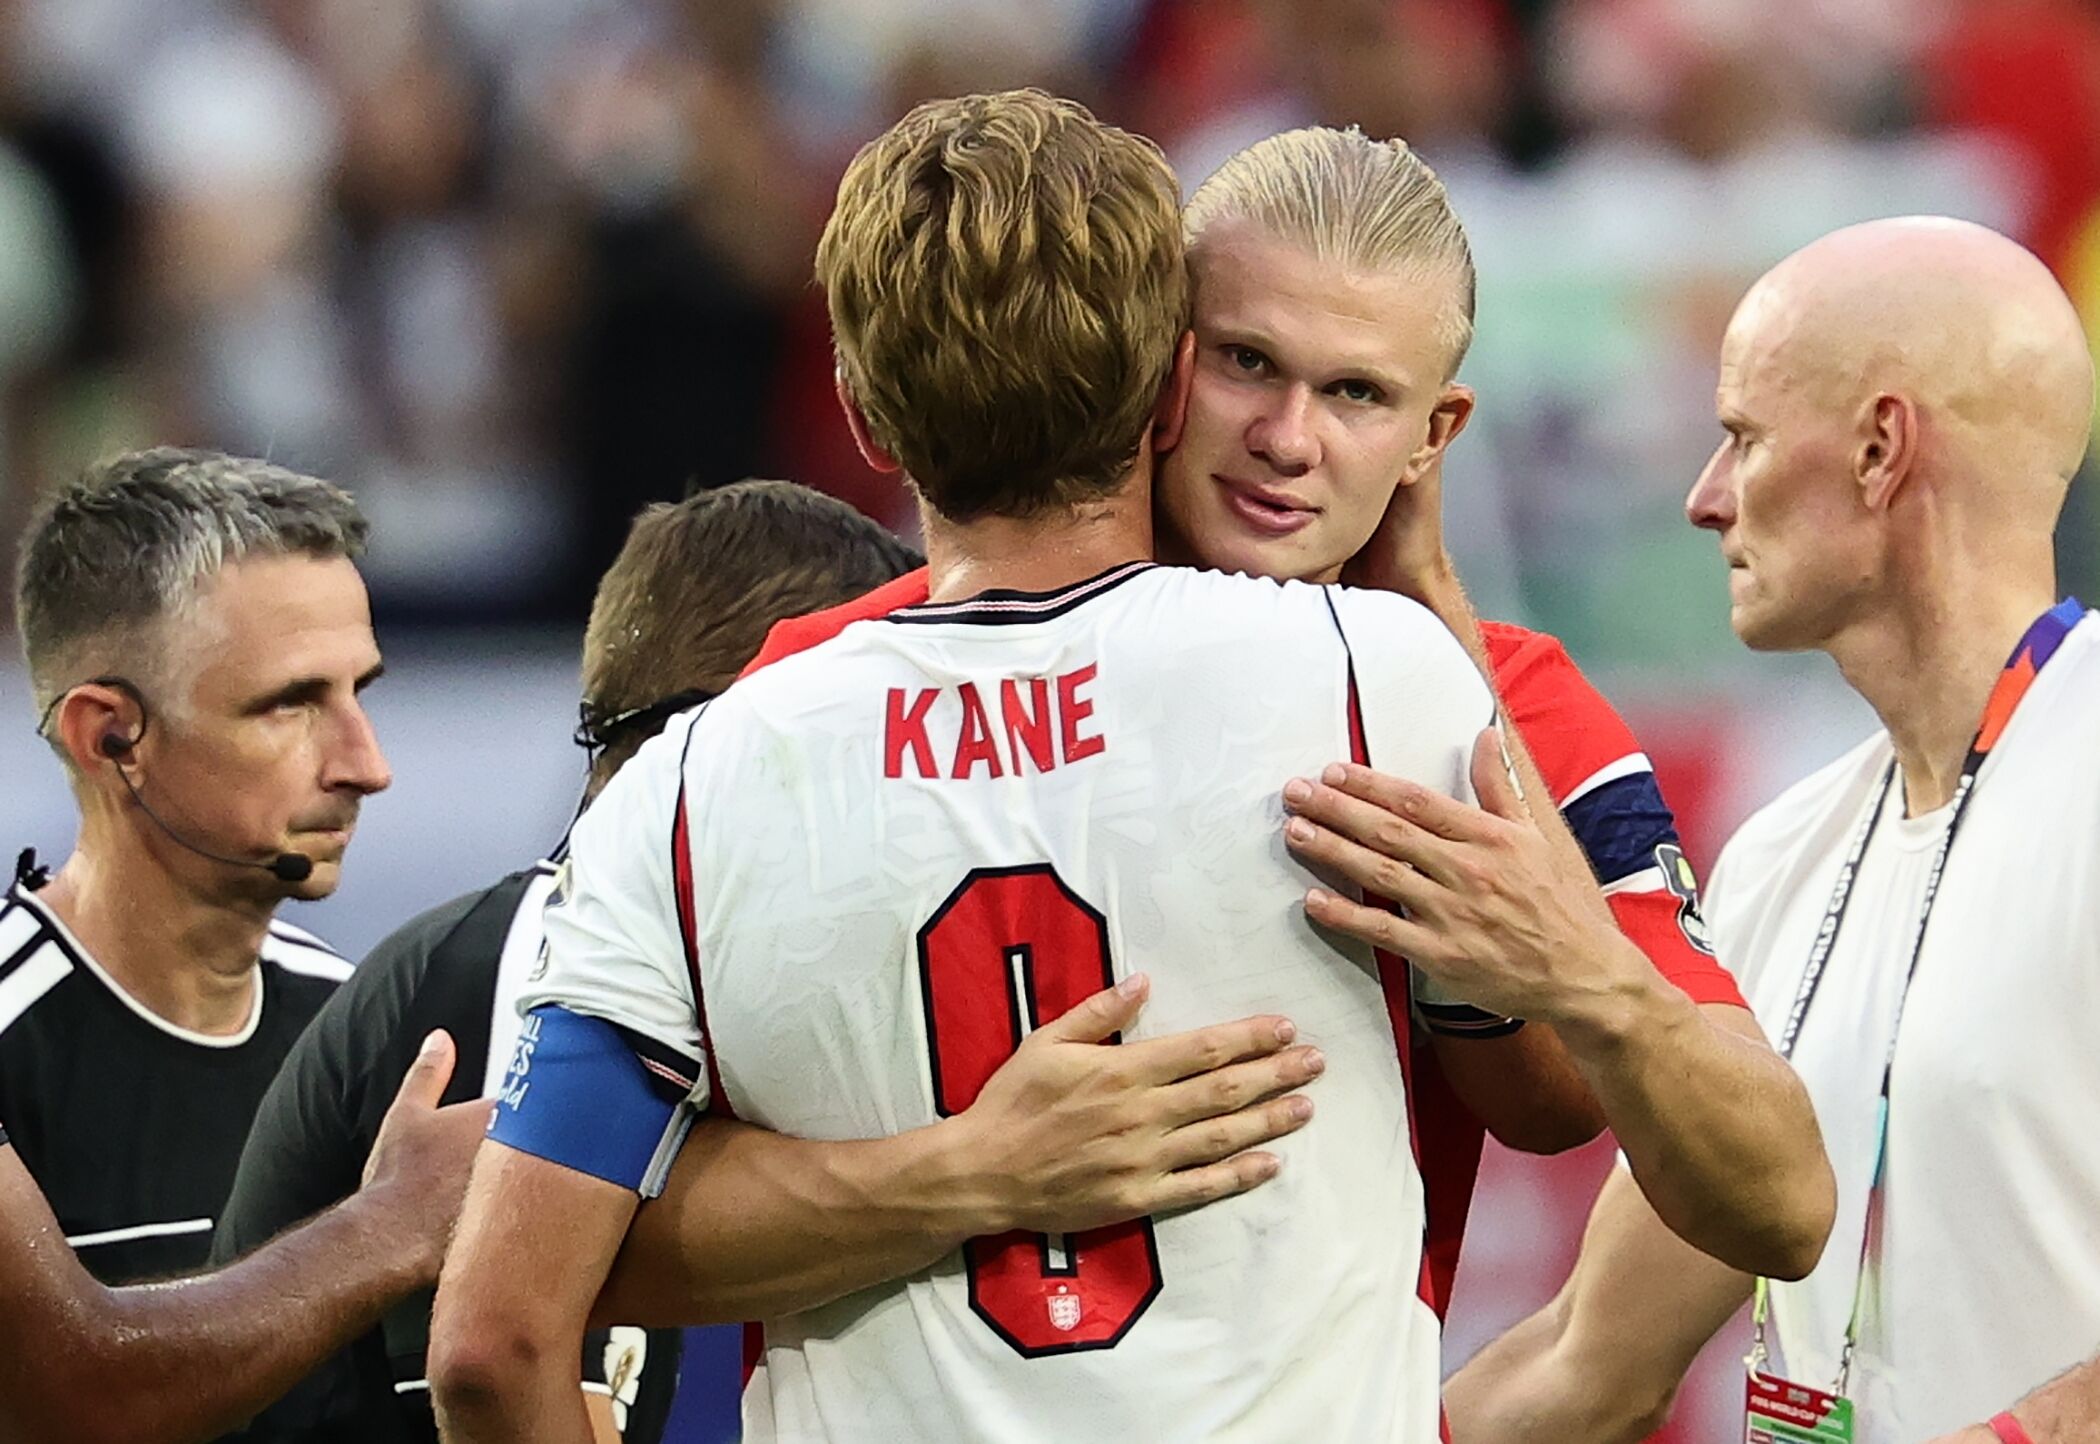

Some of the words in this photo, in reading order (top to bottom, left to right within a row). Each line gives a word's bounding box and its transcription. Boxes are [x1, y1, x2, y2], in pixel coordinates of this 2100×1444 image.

[884, 660, 1106, 780] KANE
[1798, 914, 1838, 1001] WORLD
[1827, 864, 1853, 914] CUP
